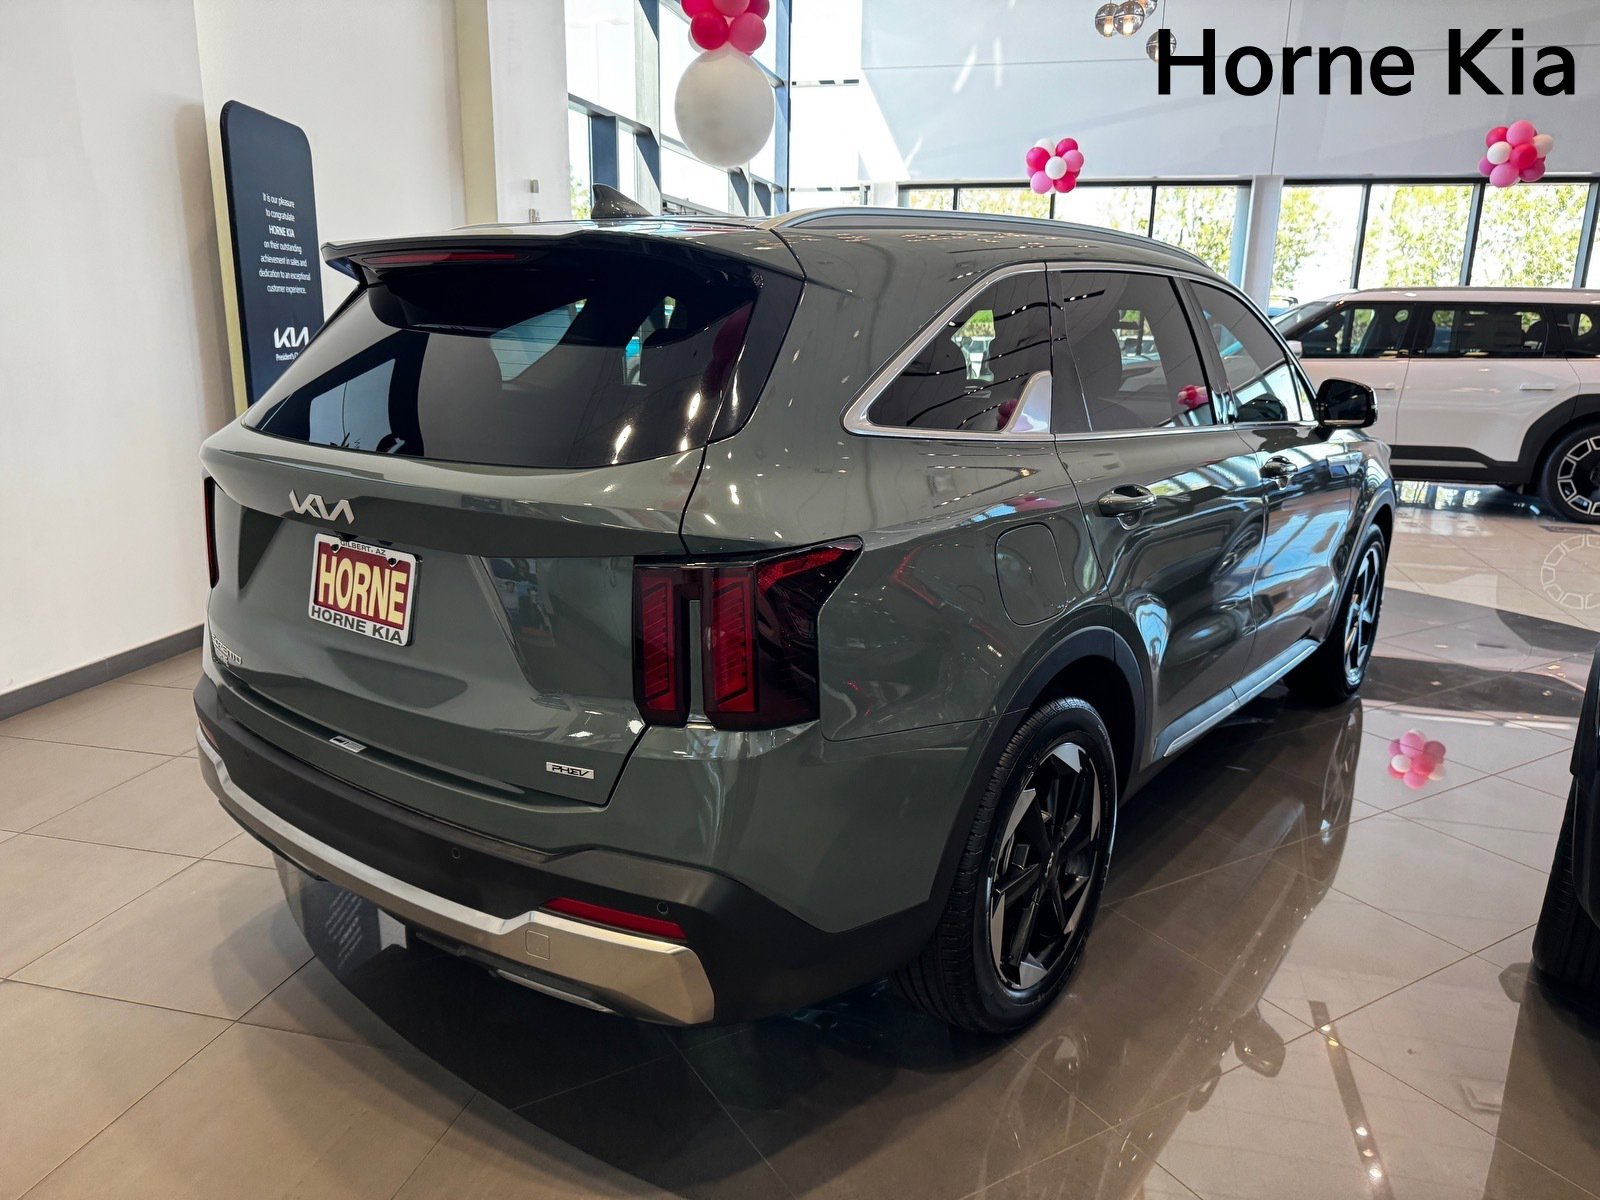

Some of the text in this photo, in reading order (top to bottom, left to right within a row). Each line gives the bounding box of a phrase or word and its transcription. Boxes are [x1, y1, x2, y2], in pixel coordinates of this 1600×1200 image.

[270, 196, 278, 204] our
[278, 197, 295, 208] pleasure
[265, 208, 295, 222] to congratulate
[268, 224, 295, 238] HORNE KIA
[263, 240, 302, 255] on their outstanding
[260, 253, 307, 267] achievement in sales and
[258, 268, 311, 282] dedication to an exceptional
[266, 285, 307, 295] customer experience.
[273, 326, 310, 349] KIA
[289, 489, 355, 525] KIA
[375, 547, 386, 556] AZ
[318, 553, 408, 625] HORNE
[311, 605, 403, 644] HORNE KIA
[551, 765, 590, 776] PHEV
